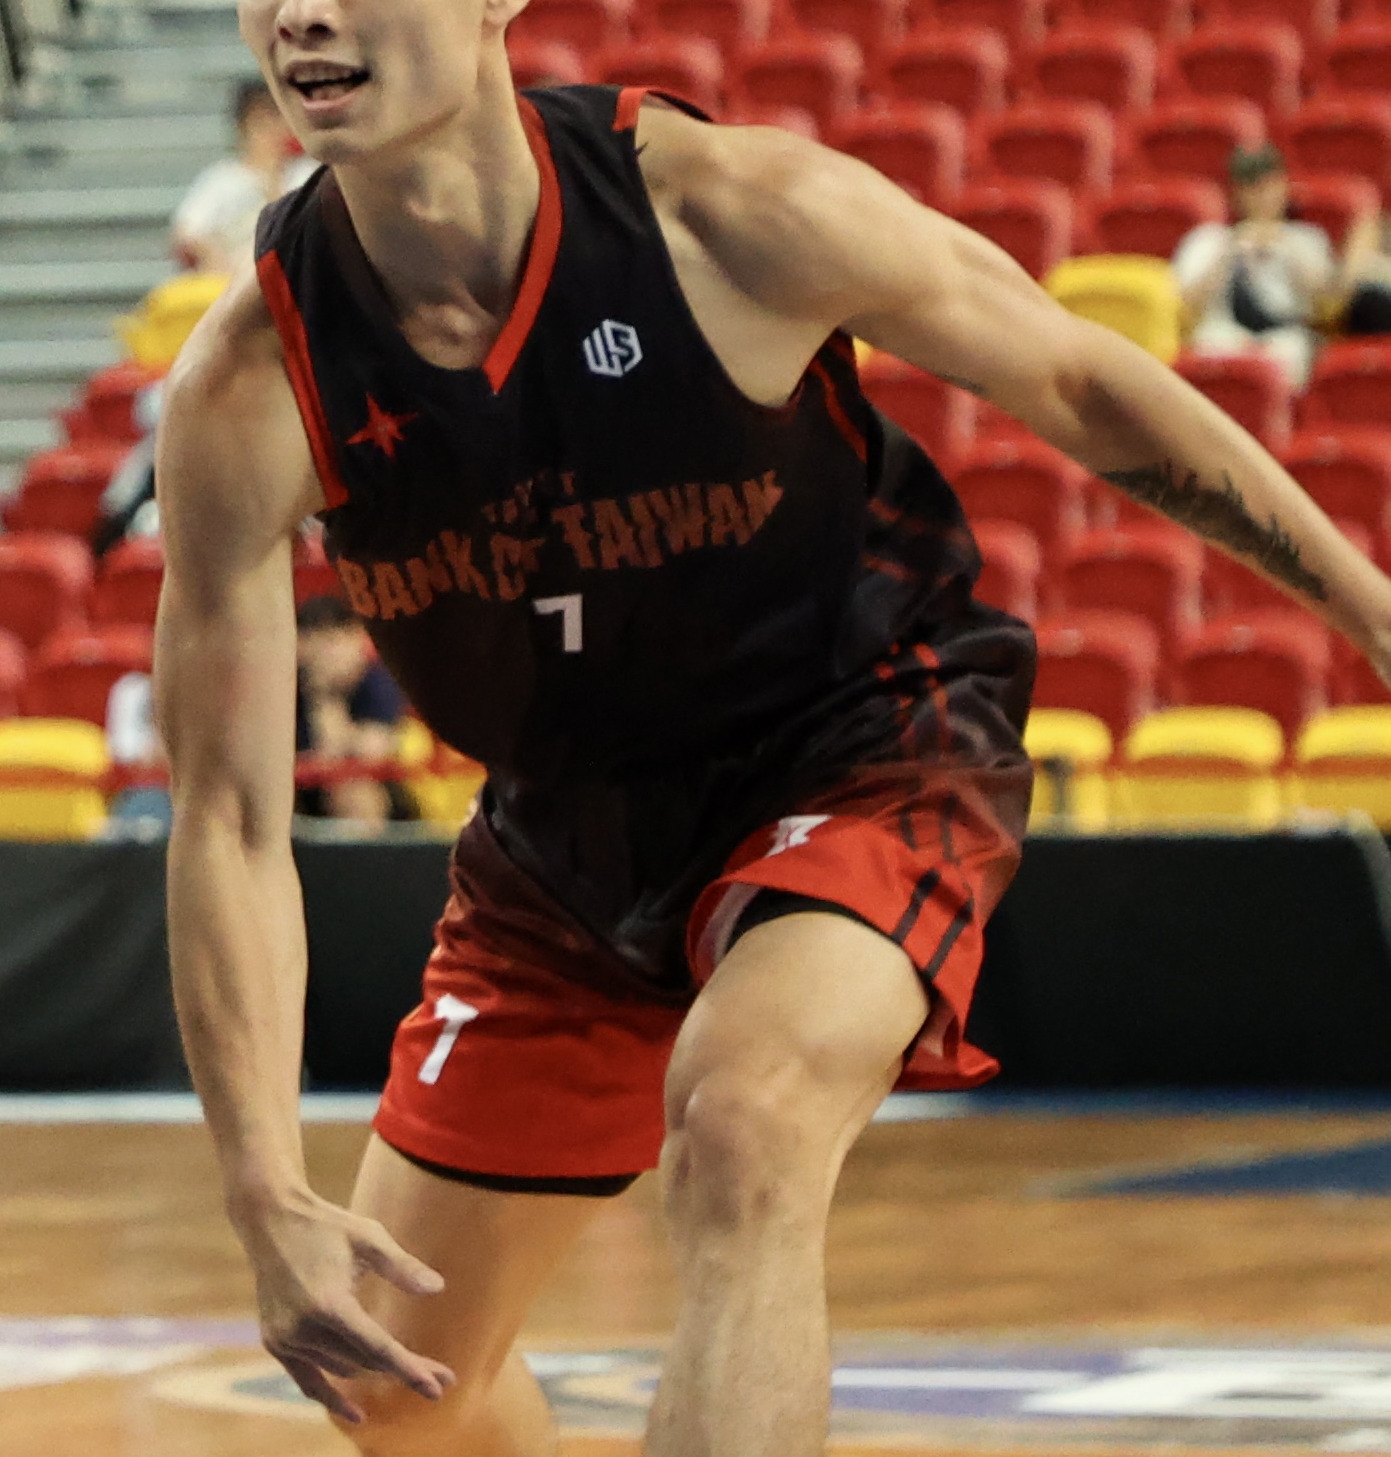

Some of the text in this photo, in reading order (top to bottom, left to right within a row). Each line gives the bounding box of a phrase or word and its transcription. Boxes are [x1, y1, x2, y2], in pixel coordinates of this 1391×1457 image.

[337, 529, 491, 620] BANK
[550, 470, 785, 571] TAIWAN
[532, 593, 583, 653] 7
[418, 992, 479, 1085] 7
